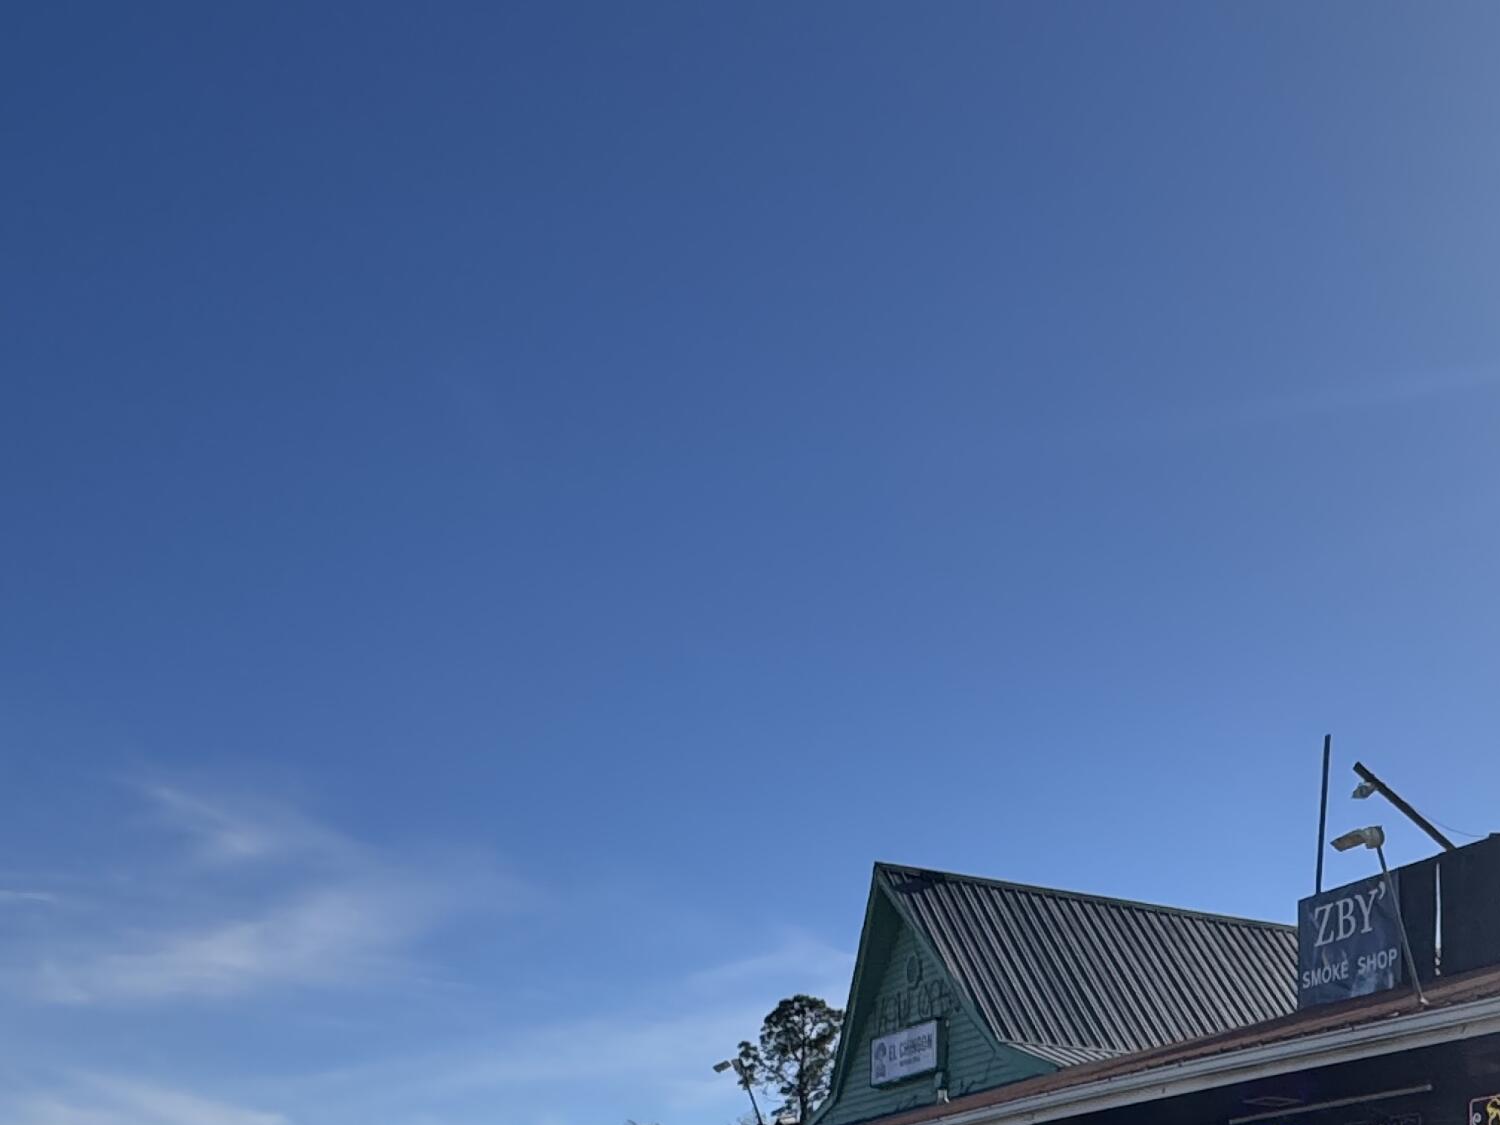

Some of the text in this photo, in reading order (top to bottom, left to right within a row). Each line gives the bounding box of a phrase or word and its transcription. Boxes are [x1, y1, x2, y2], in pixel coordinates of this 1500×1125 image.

[1313, 881, 1386, 947] ZBY'
[1302, 948, 1398, 989] SMOKE SHOP
